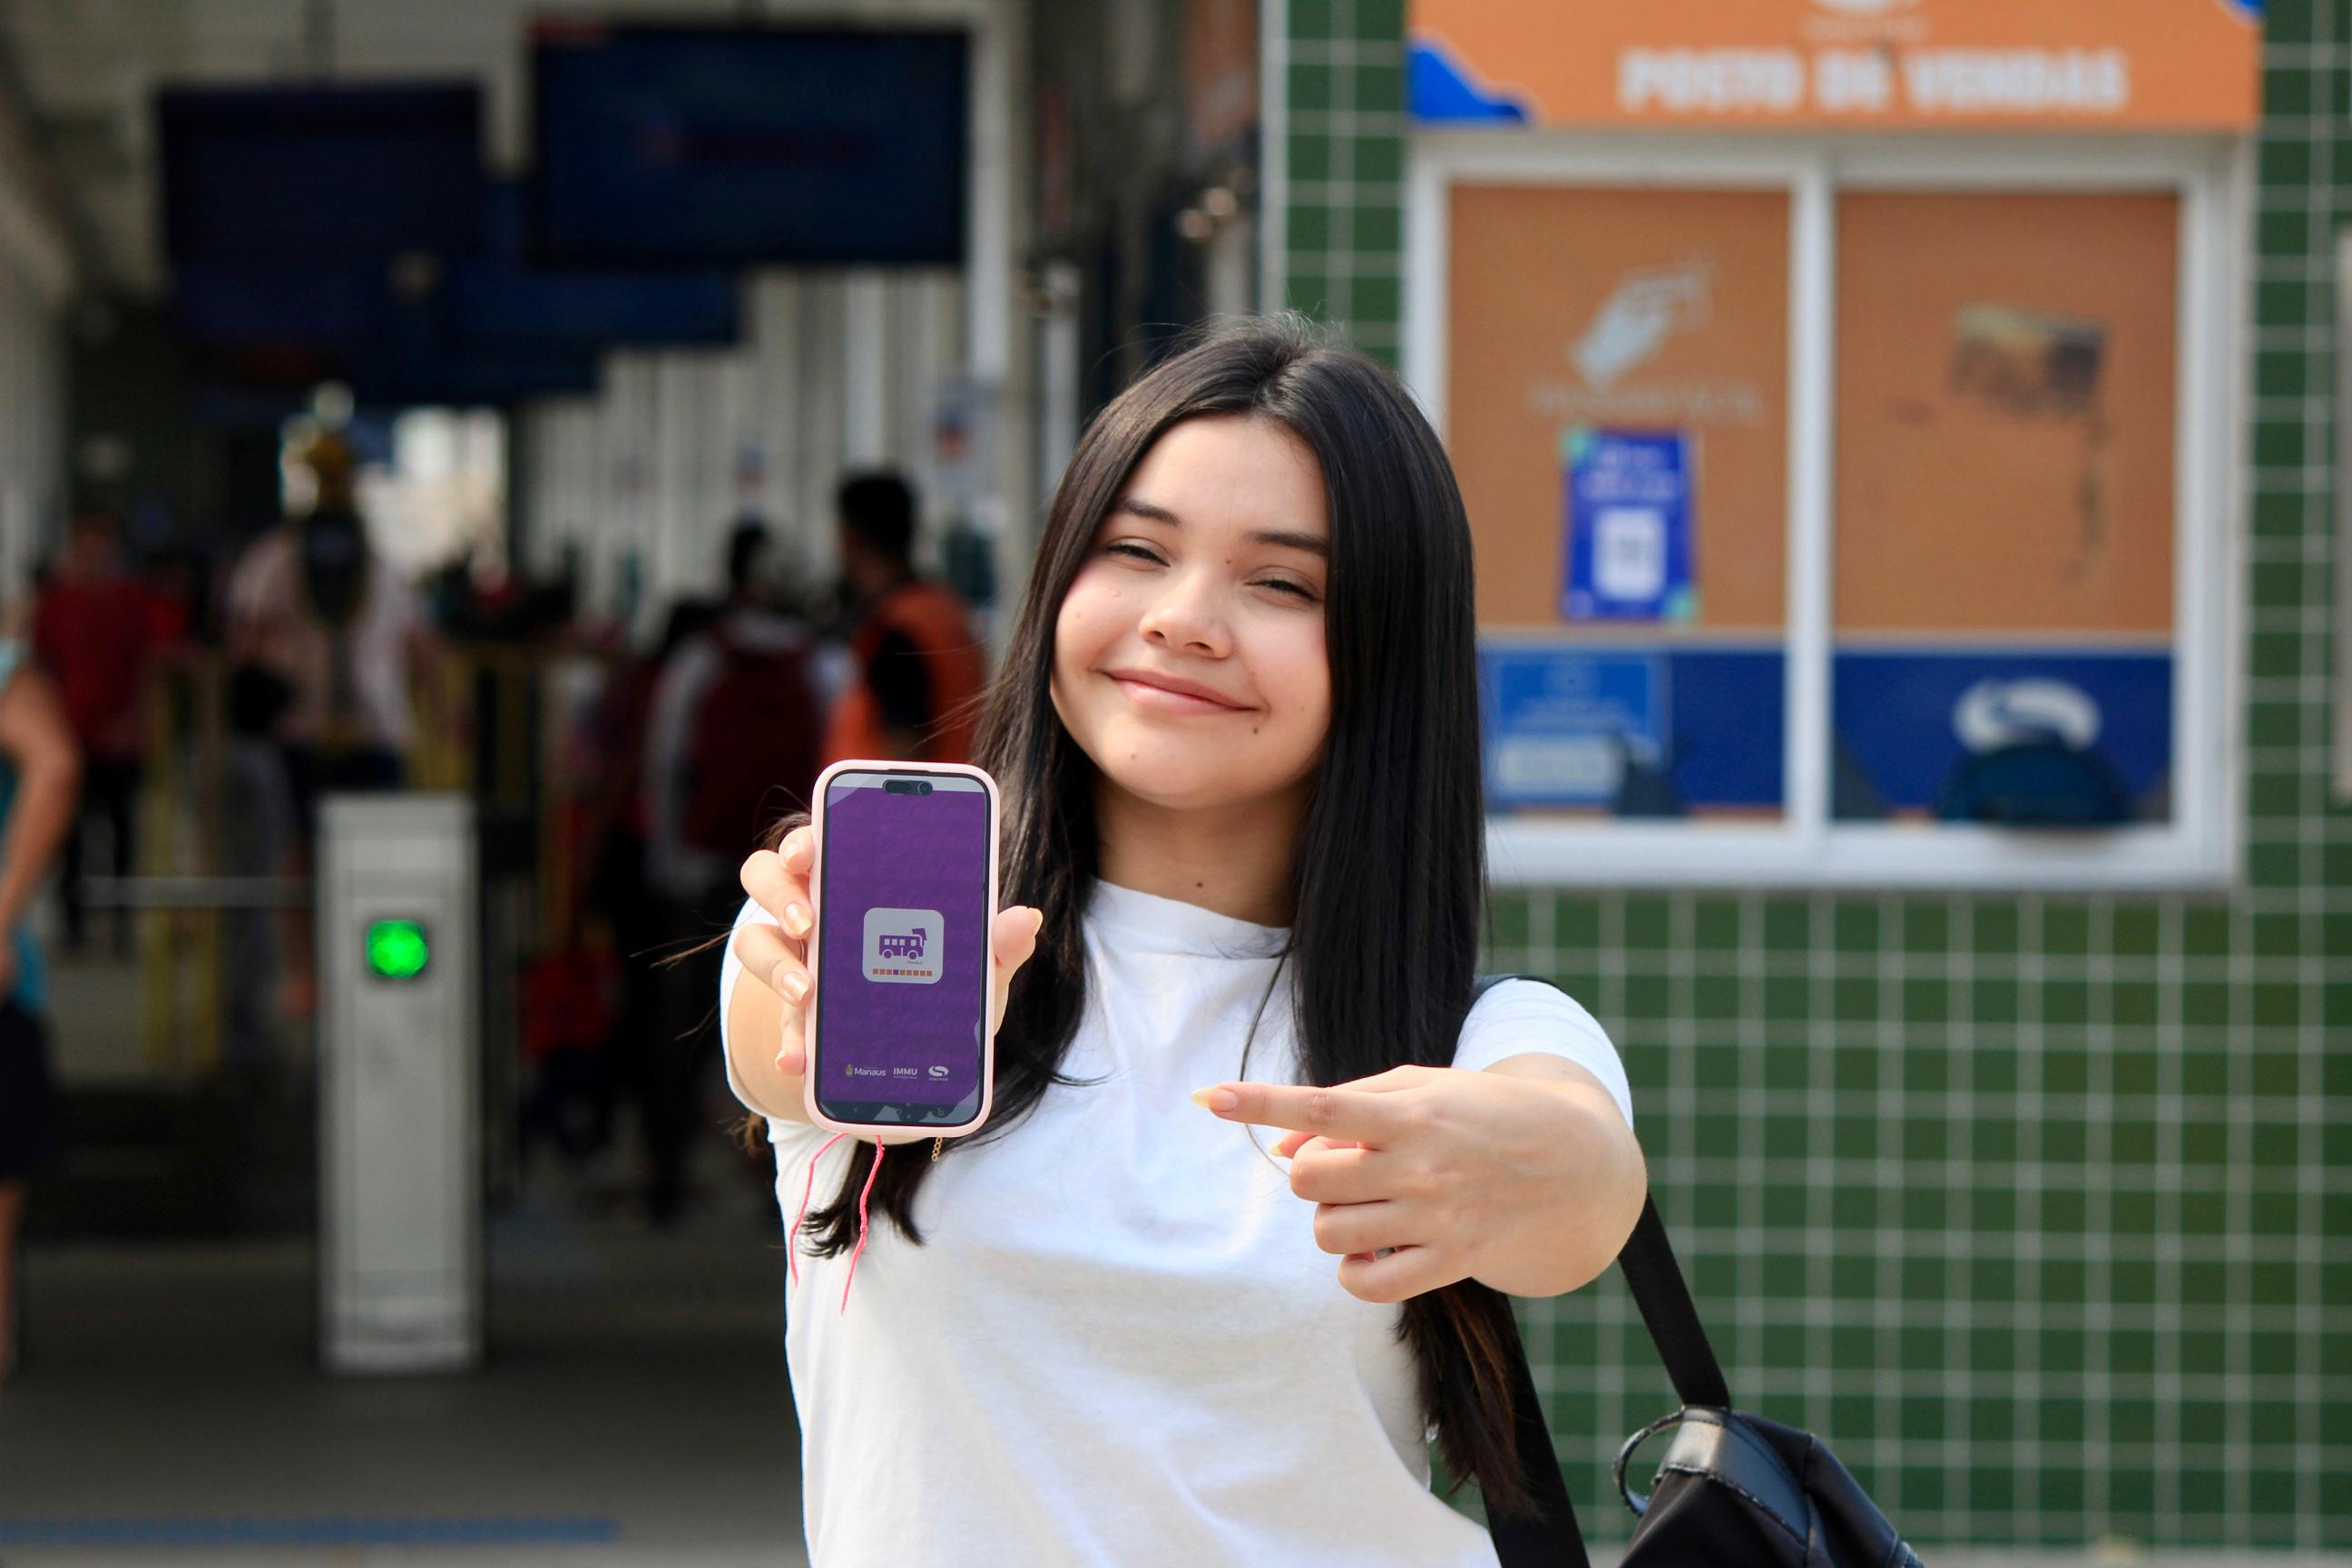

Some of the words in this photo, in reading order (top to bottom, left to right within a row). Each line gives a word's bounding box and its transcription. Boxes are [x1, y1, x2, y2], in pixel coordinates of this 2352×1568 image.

[1622, 50, 1802, 110] POSTO
[1817, 52, 1887, 110] DE
[1908, 50, 2127, 111] VENDAS
[854, 1067, 887, 1076] Manaus
[893, 1067, 917, 1076] IMMU
